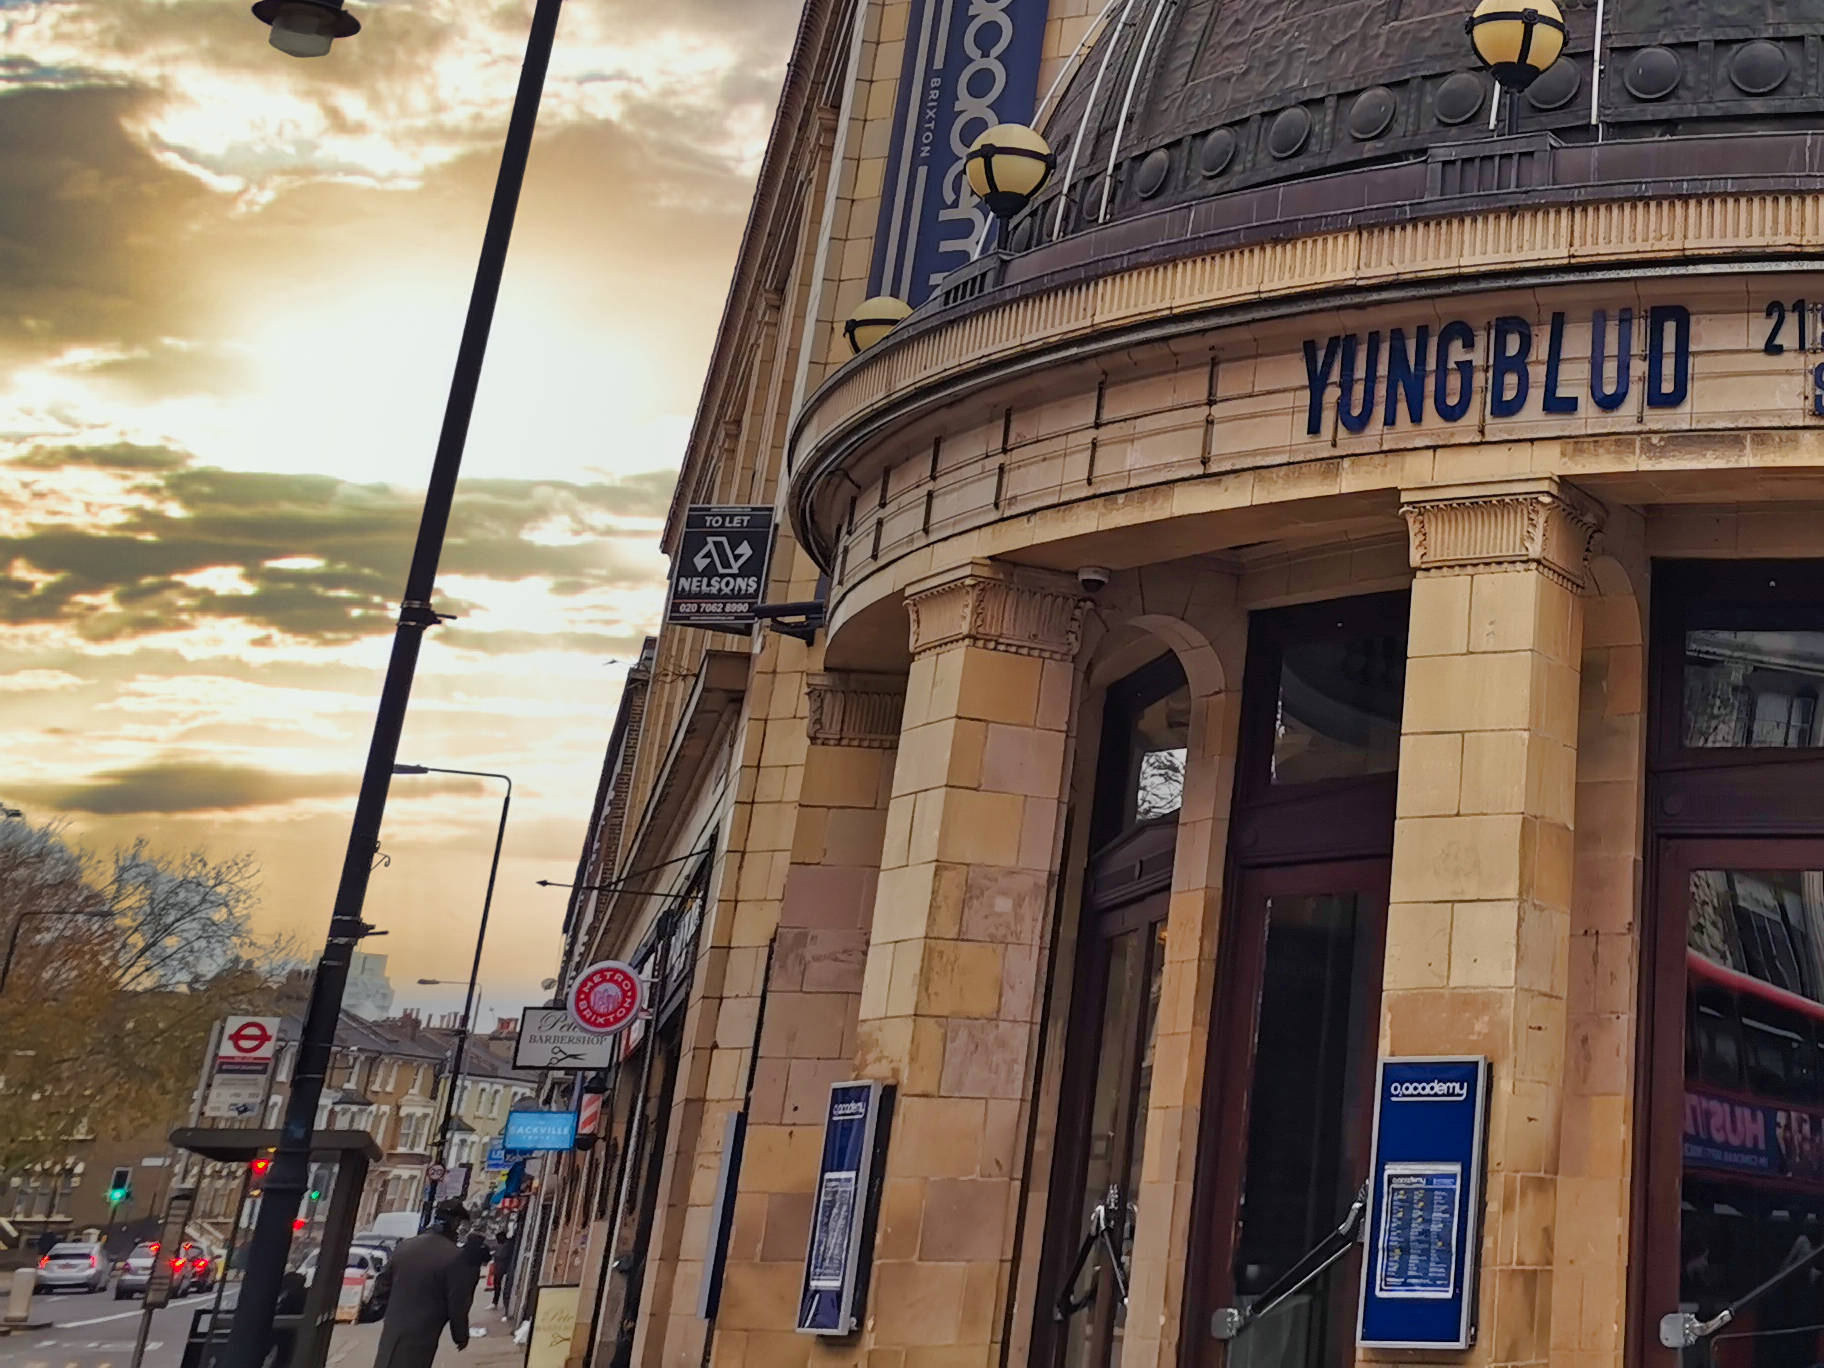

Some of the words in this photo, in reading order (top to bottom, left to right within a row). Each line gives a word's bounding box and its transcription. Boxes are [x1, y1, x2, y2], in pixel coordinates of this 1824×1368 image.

[920, 77, 942, 159] BRIXTON
[1302, 305, 1690, 435] YUNGBLUD
[704, 515, 723, 527] TO
[724, 515, 751, 527] LET
[677, 576, 758, 593] NELSONS
[679, 603, 698, 613] 020
[699, 603, 724, 613] 7062
[724, 603, 749, 613] 8990
[581, 971, 632, 993] METRO
[578, 997, 633, 1025] BRIXTON
[528, 1034, 608, 1046] BARBERSHOP
[430, 1168, 443, 1176] 20
